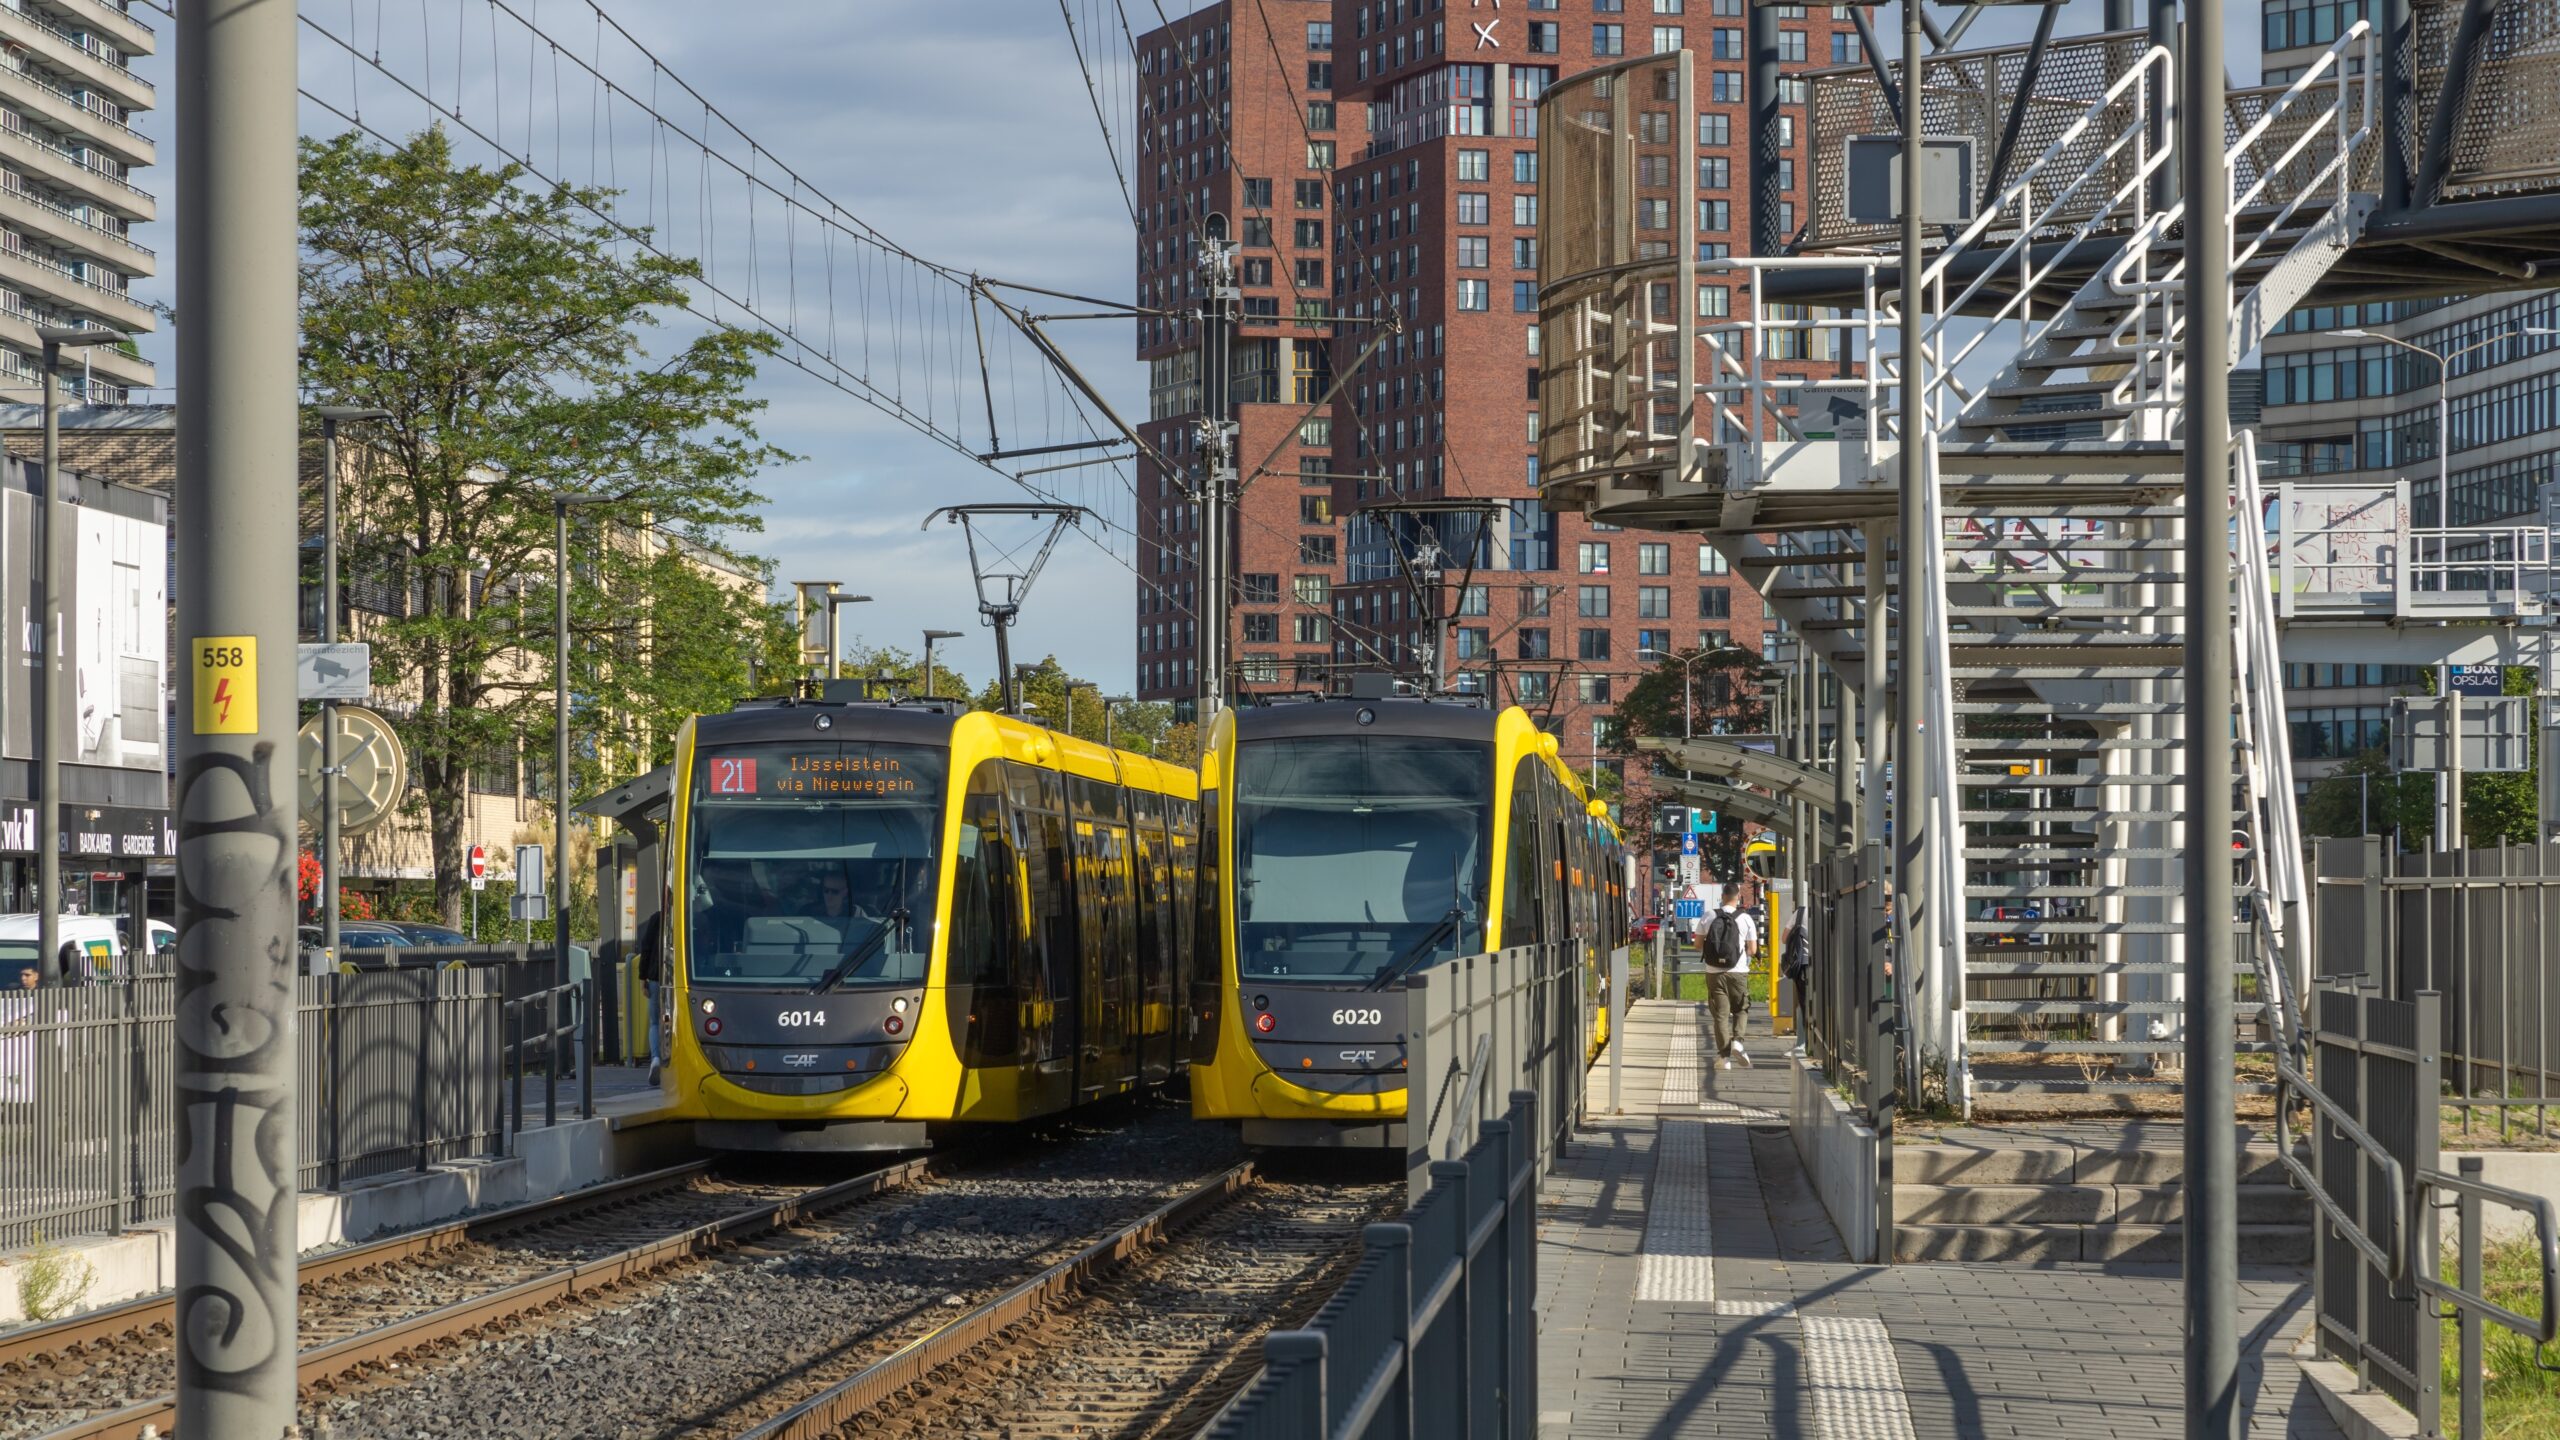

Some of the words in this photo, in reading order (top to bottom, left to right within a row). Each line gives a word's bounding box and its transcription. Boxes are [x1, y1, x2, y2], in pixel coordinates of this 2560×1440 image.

[202, 647, 244, 668] 558
[298, 646, 365, 654] ameratoezicht
[2452, 675, 2499, 686] OPSLAG
[791, 757, 900, 771] IJsselstein
[721, 759, 745, 792] 21
[777, 777, 804, 791] via
[813, 777, 914, 794] Nieuwegein
[79, 832, 113, 854] BADKAMER
[122, 834, 155, 855] GARDEROBE
[778, 1010, 826, 1027] 6014
[1332, 1009, 1382, 1025] 6020
[782, 1054, 819, 1067] CAF
[1339, 1050, 1376, 1063] CAF
